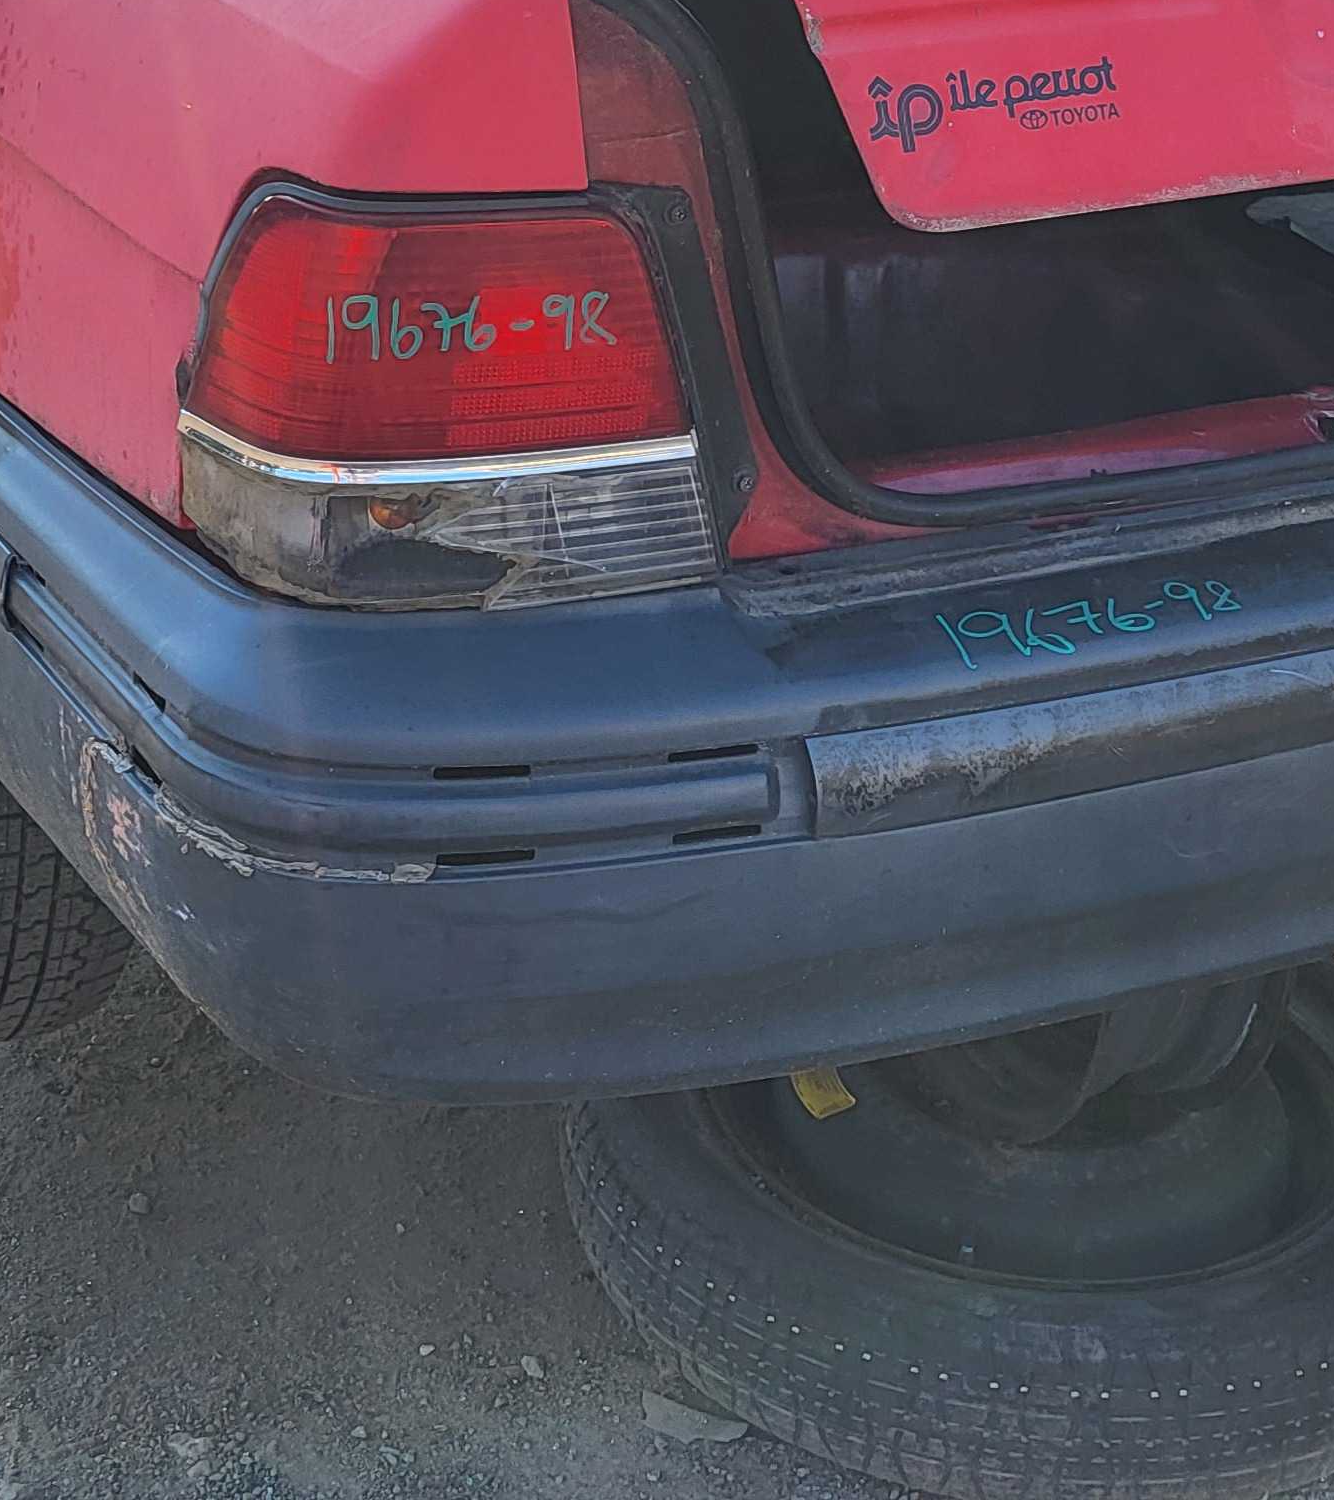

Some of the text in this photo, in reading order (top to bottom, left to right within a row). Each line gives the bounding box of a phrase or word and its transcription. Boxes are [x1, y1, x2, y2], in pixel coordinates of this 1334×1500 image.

[1050, 102, 1120, 126] TOYOTA
[324, 292, 618, 364] 19676-98
[934, 580, 1243, 670] 19676-98
